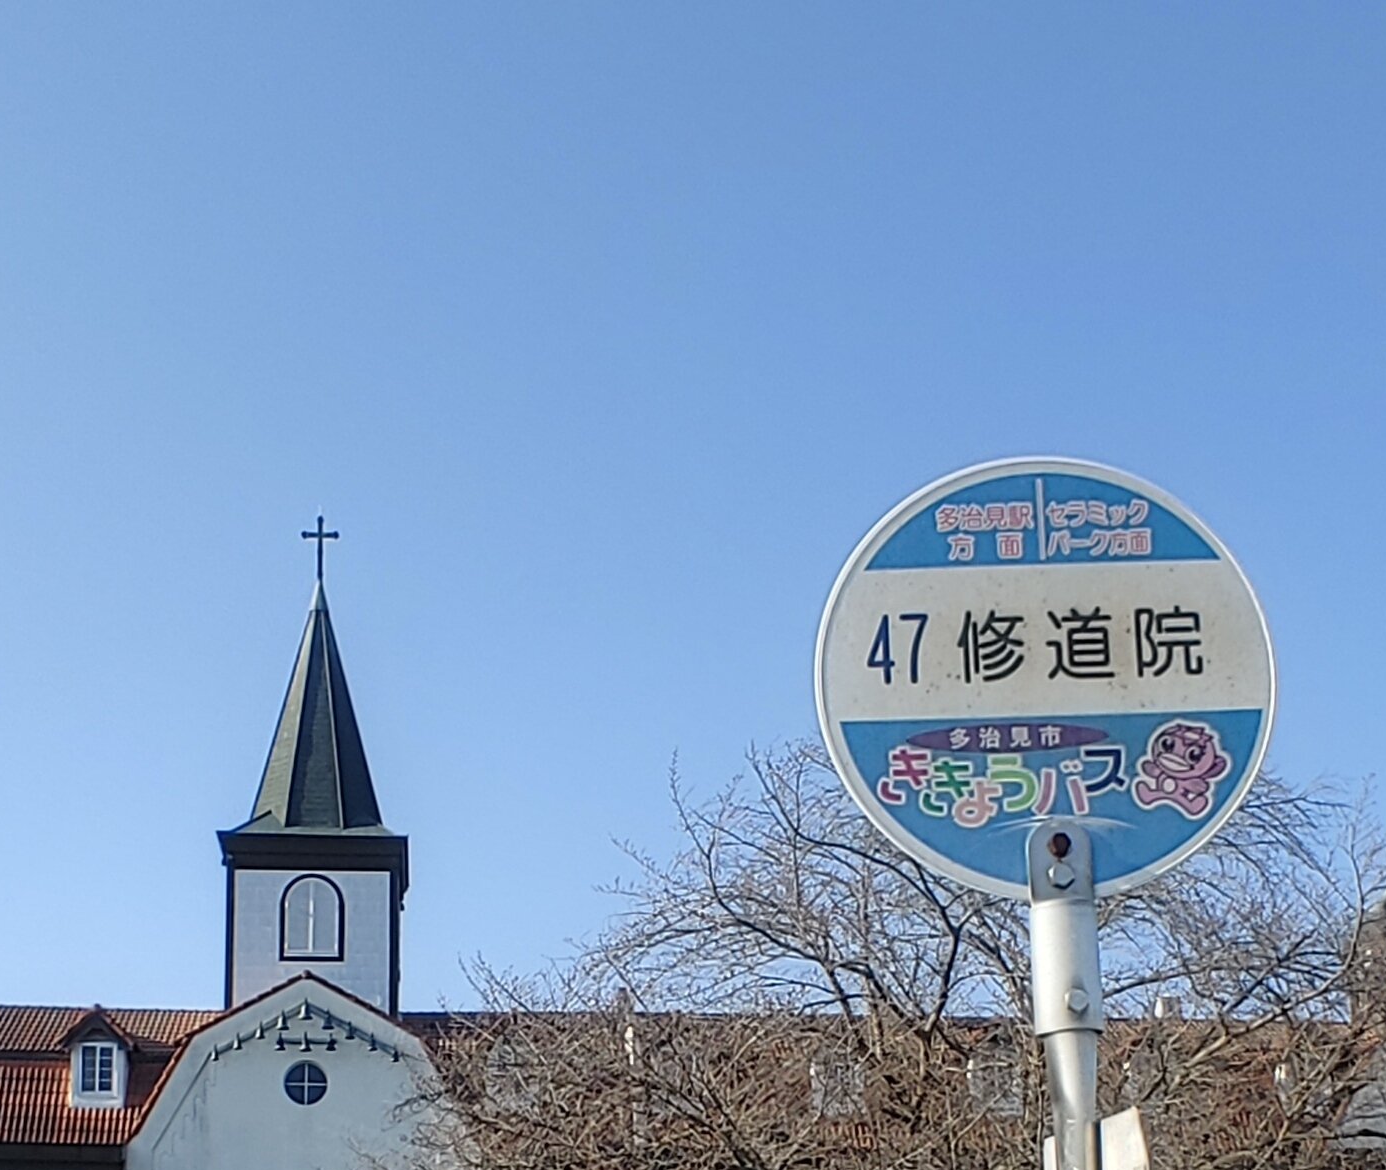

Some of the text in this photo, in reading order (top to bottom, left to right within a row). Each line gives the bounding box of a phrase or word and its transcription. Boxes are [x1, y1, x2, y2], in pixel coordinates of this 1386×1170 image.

[936, 503, 1034, 533] 多治見駅
[1046, 500, 1149, 528] セラミック
[1047, 528, 1152, 557] パーク方面
[866, 605, 1205, 685] 47 修道院
[948, 724, 1064, 749] 多治見市
[876, 746, 1128, 829] ききょうバス
